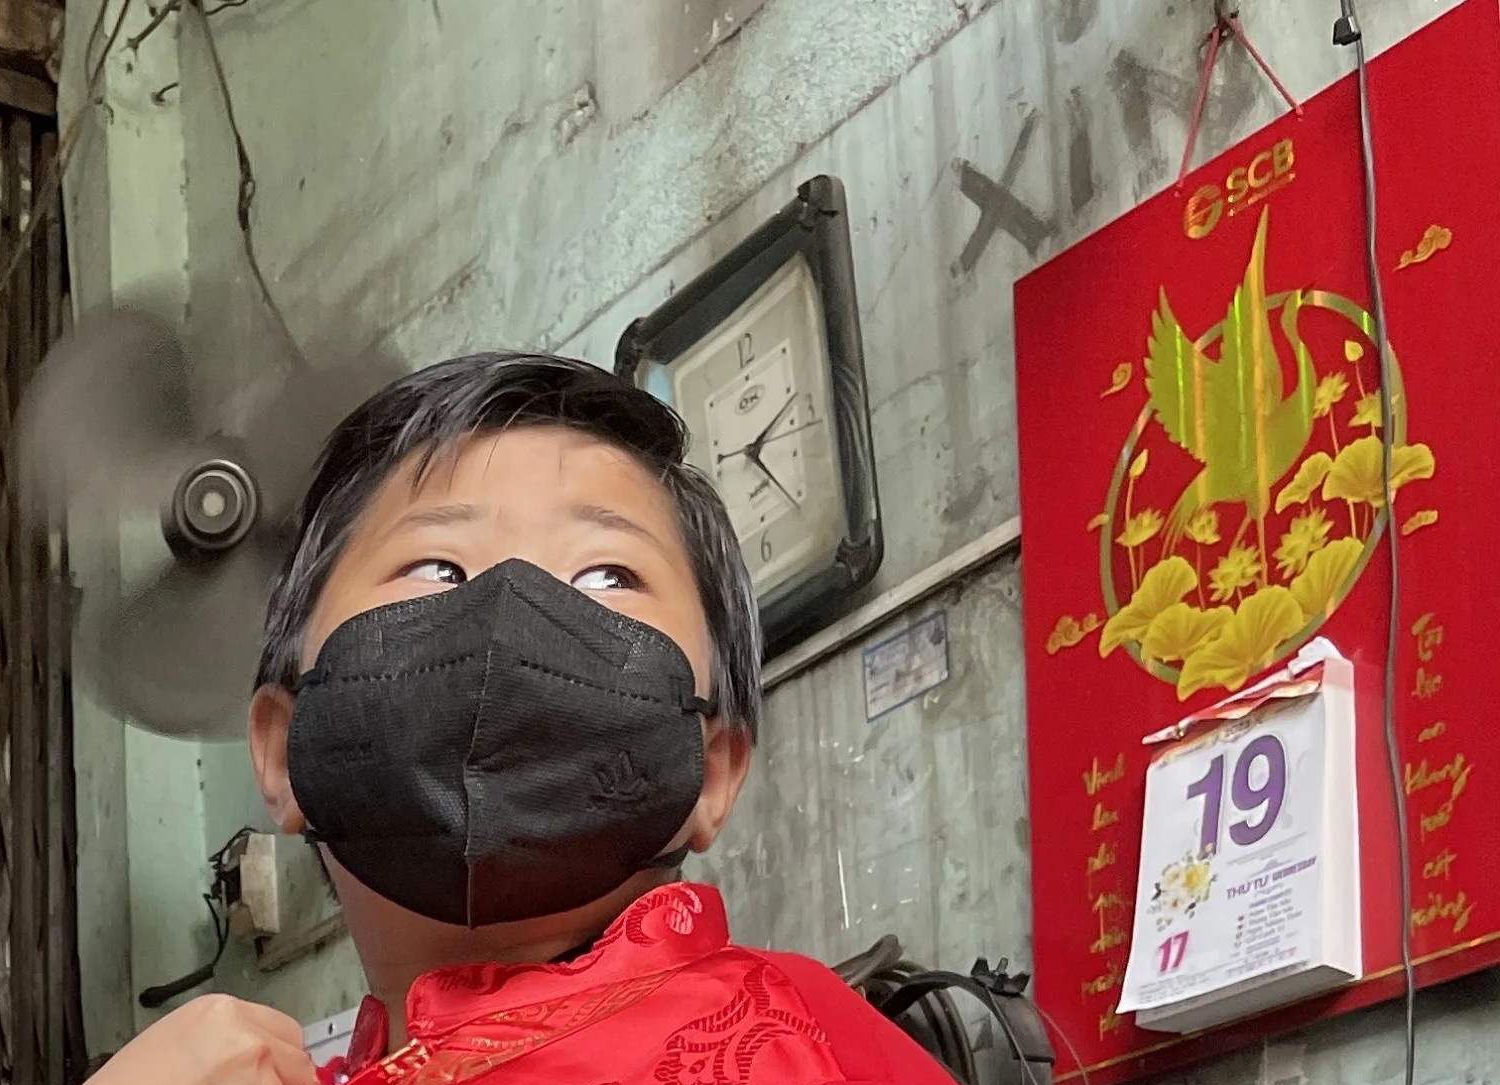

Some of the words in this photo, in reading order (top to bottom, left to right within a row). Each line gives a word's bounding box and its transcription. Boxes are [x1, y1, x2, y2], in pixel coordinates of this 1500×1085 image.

[1226, 138, 1295, 203] SCB
[737, 333, 755, 369] 12
[761, 528, 772, 562] 6
[1187, 734, 1286, 860] 19
[1158, 930, 1189, 973] 17
